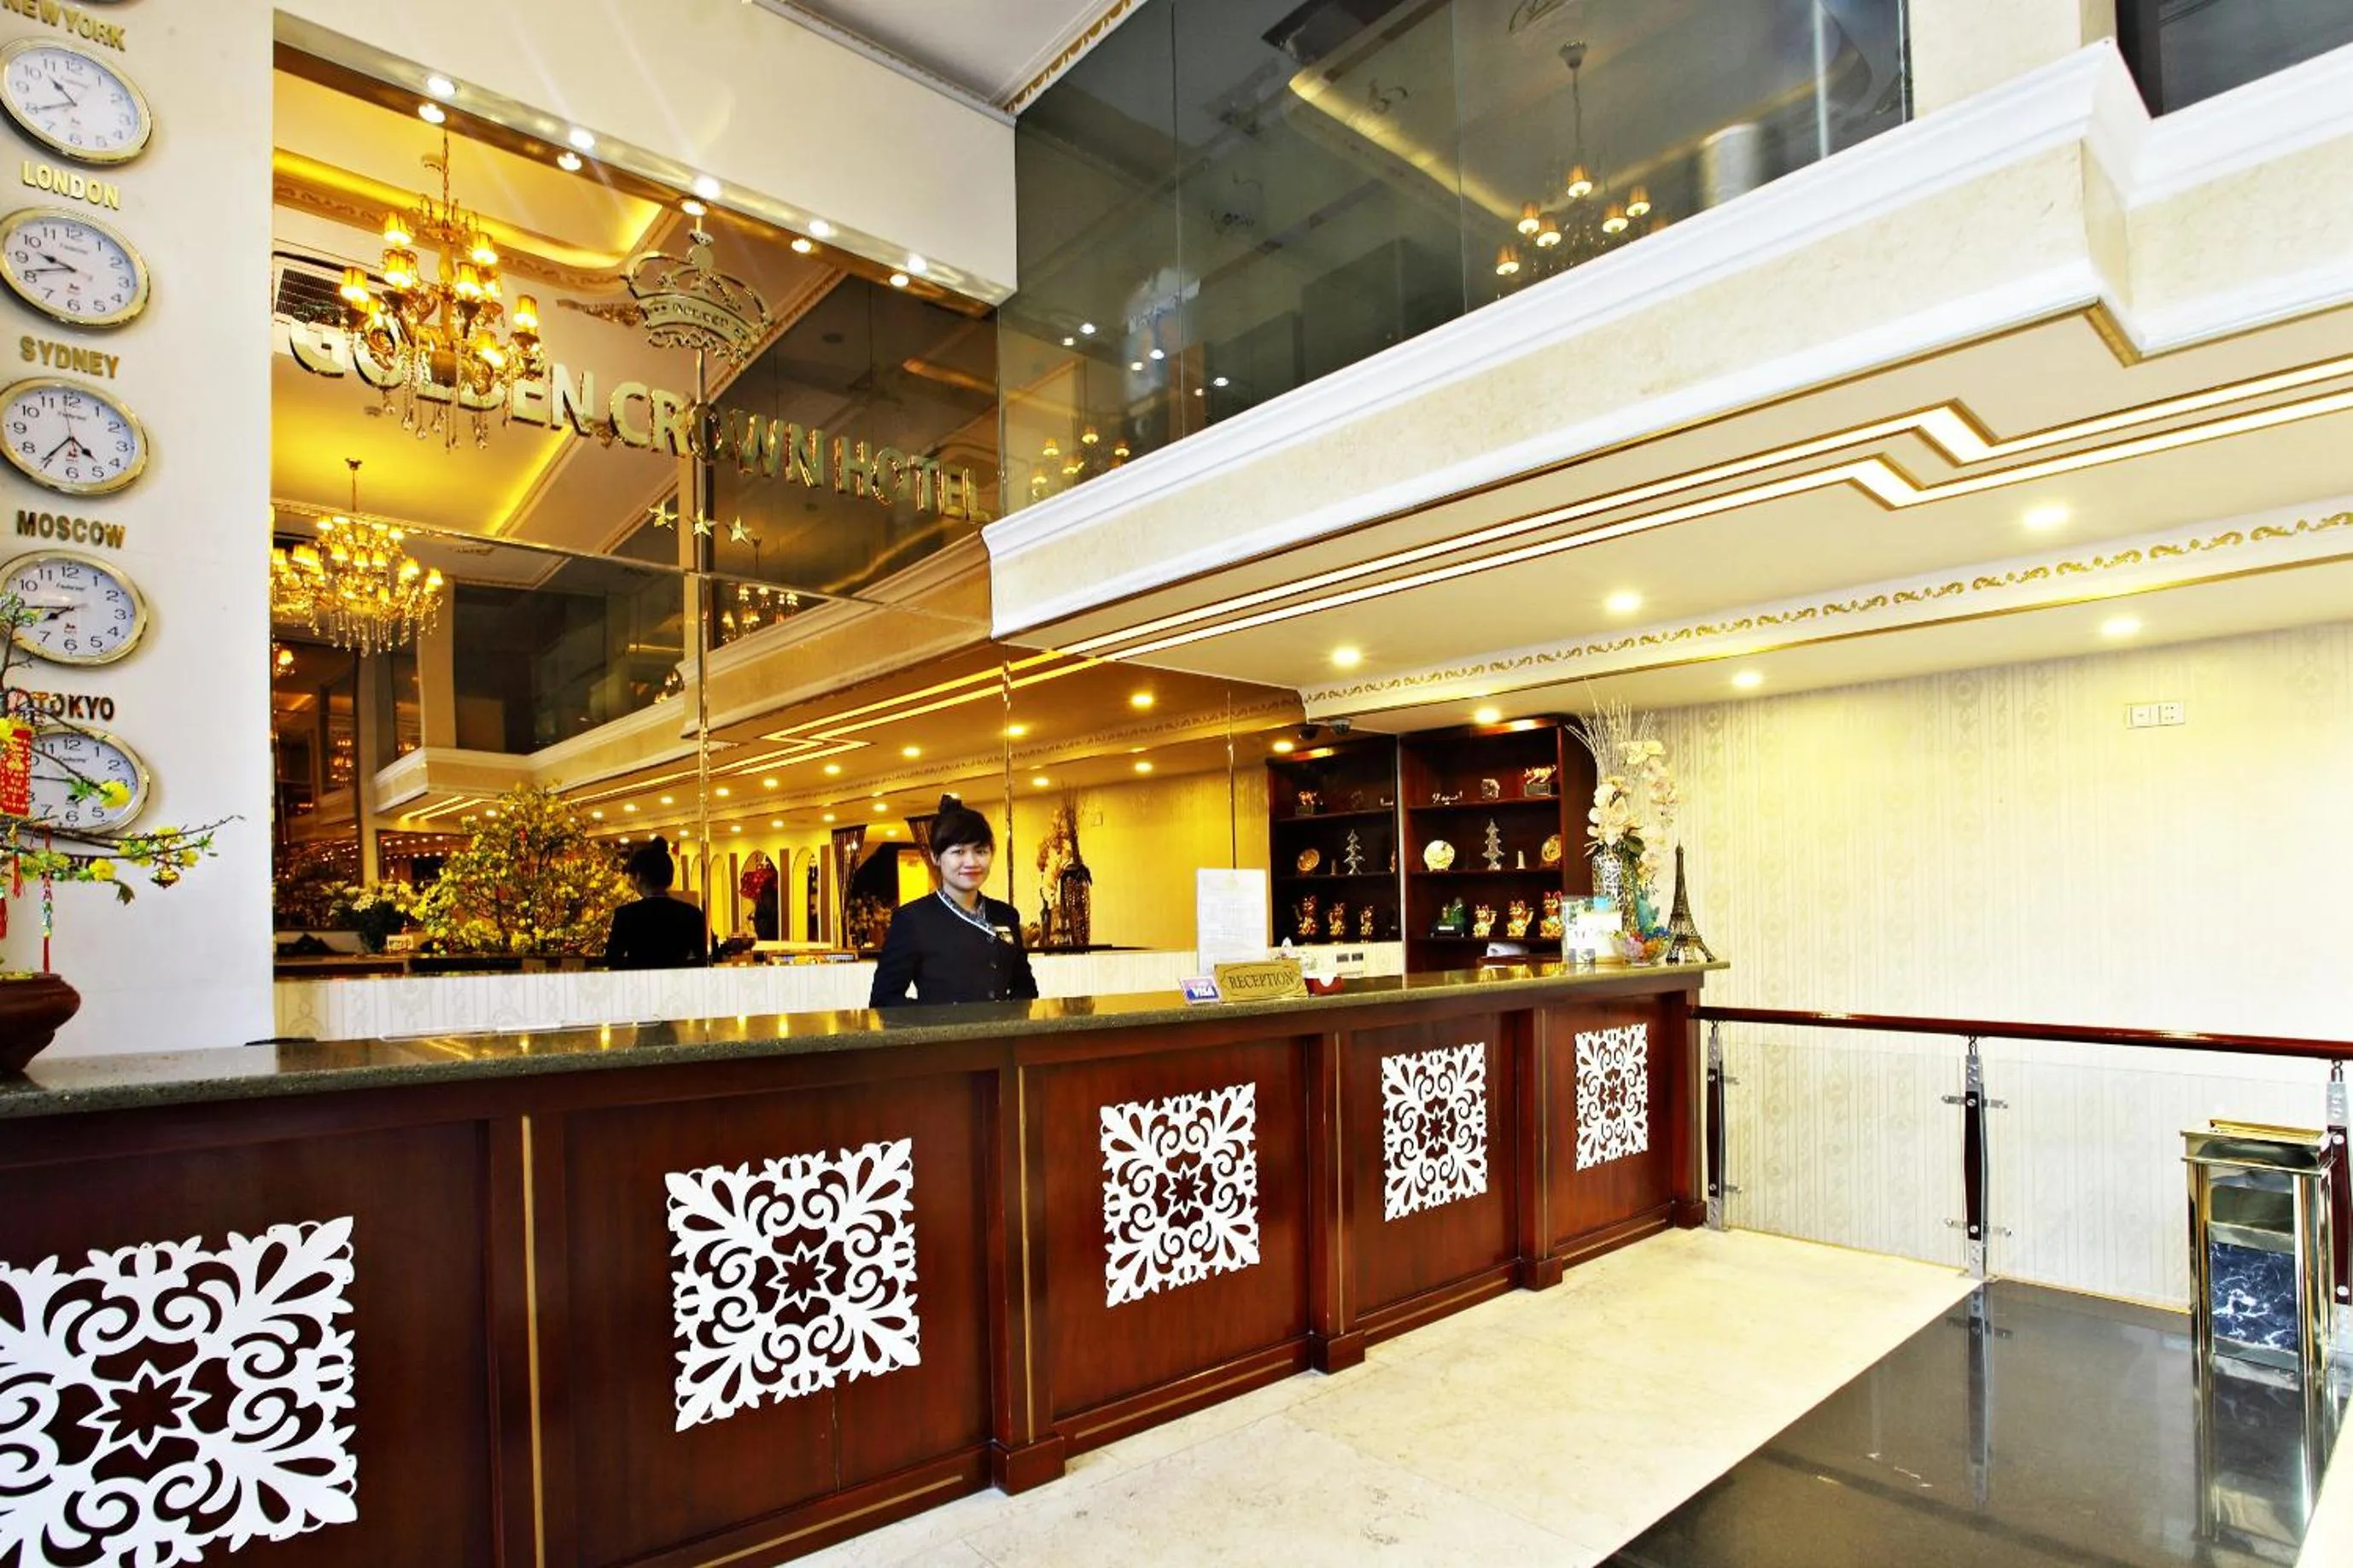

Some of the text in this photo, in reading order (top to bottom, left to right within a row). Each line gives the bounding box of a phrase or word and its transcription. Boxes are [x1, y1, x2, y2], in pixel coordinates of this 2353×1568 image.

[22, 160, 120, 211] LONDON
[44, 227, 55, 240] 11
[66, 227, 83, 241] 12
[25, 235, 41, 248] 10
[15, 251, 28, 264] 9
[110, 257, 121, 268] 2
[24, 271, 37, 283] 8
[119, 277, 129, 289] 3
[42, 288, 55, 299] 7
[111, 294, 121, 303] 4
[67, 300, 80, 312] 6
[94, 300, 105, 312] 5
[20, 335, 120, 379] SYDNEY
[42, 396, 54, 409] 11
[63, 395, 81, 408] 12
[22, 405, 39, 418] 10
[14, 422, 26, 434] 9
[108, 422, 120, 434] 2
[609, 381, 825, 488] CROWN
[22, 441, 35, 454] 8
[116, 440, 128, 452] 3
[109, 458, 120, 468] 4
[66, 466, 79, 479] 6
[92, 466, 104, 478] 5
[16, 510, 126, 550] MOSCOW
[39, 569, 52, 581] 11
[61, 566, 79, 579] 12
[20, 580, 38, 592] 10
[106, 591, 119, 603] 2
[114, 609, 126, 620] 3
[38, 631, 51, 643] 7
[107, 627, 119, 637] 4
[64, 638, 78, 651] 6
[90, 636, 102, 648] 5
[30, 691, 115, 721] TOKYO
[64, 738, 81, 751] 12
[108, 760, 120, 771] 2
[41, 805, 53, 815] 7
[92, 807, 104, 818] 5
[66, 811, 79, 822] 6
[1227, 971, 1295, 989] RECEPTION
